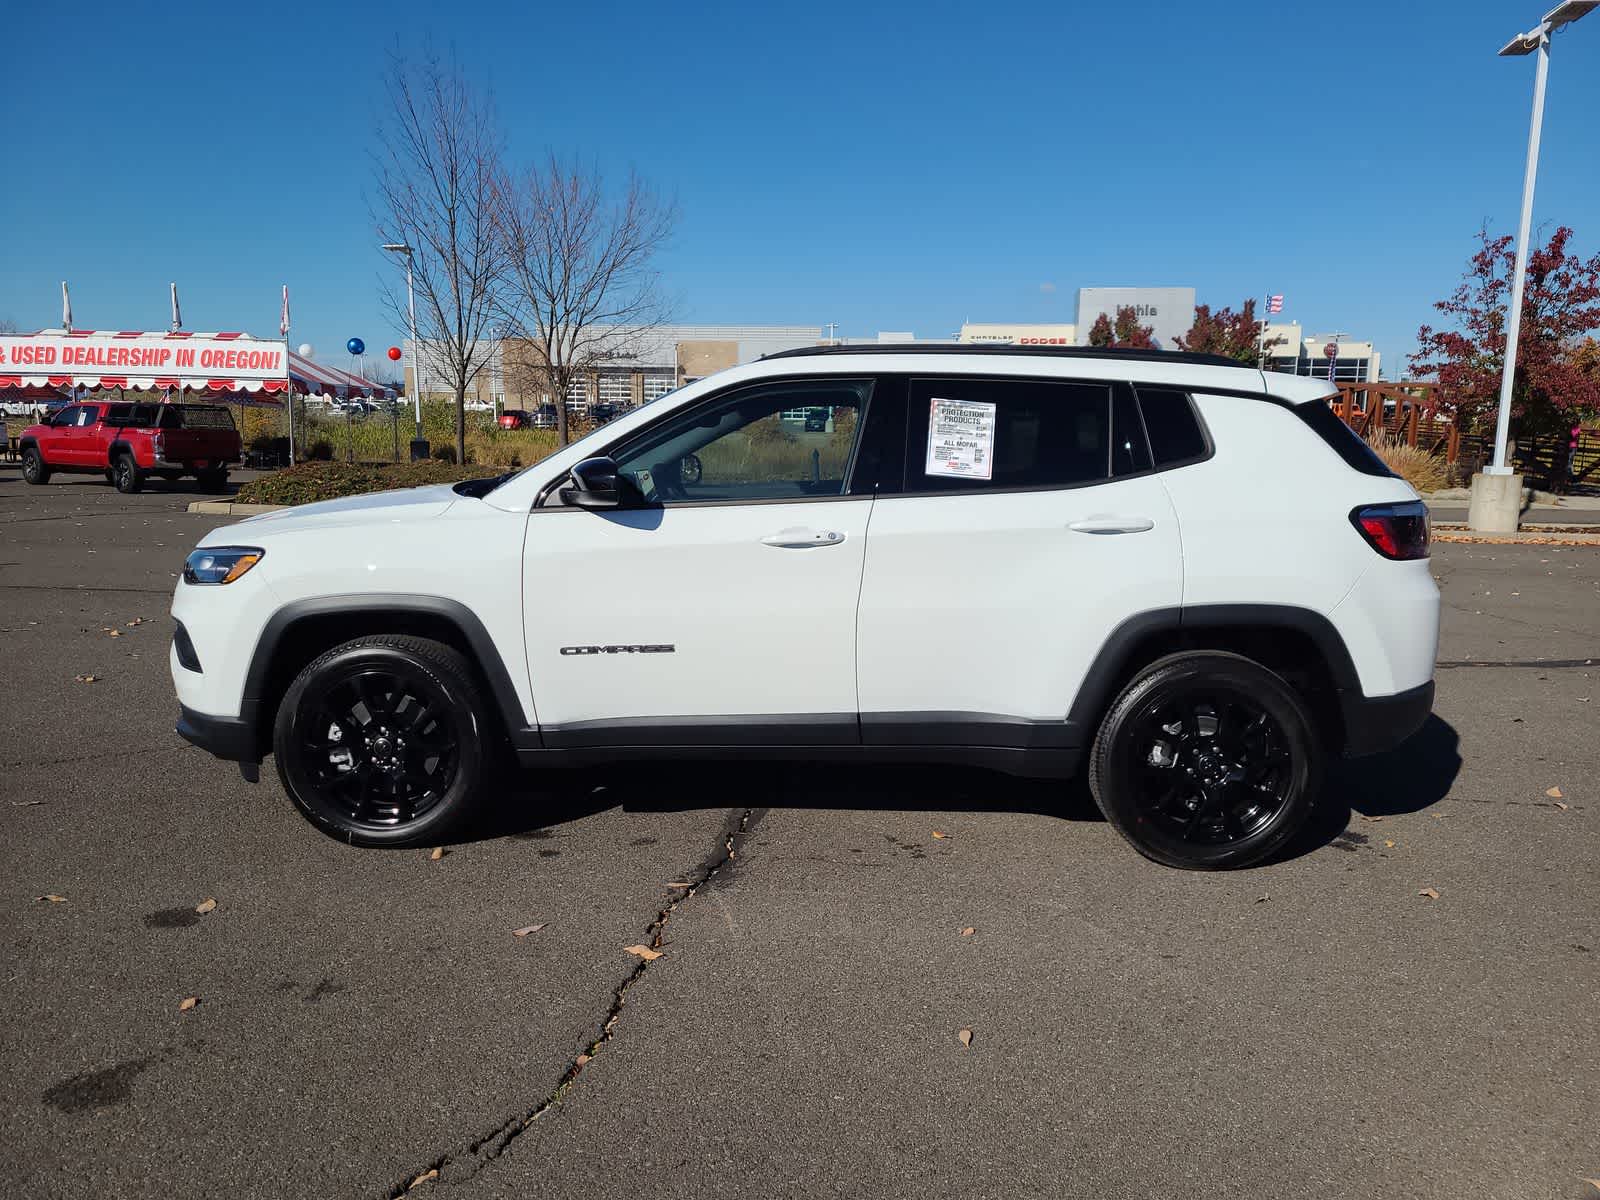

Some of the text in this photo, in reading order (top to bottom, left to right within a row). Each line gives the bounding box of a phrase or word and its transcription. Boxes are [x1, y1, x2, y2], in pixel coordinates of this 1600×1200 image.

[1116, 304, 1157, 316] Lhia
[11, 346, 56, 365] USED
[62, 346, 171, 367] DEALERSHIP
[175, 348, 196, 368] IN
[200, 349, 281, 369] OREGON!
[941, 408, 985, 418] PROTECTION
[944, 416, 981, 425] PRODUCTS
[559, 644, 675, 655] COMPASS
